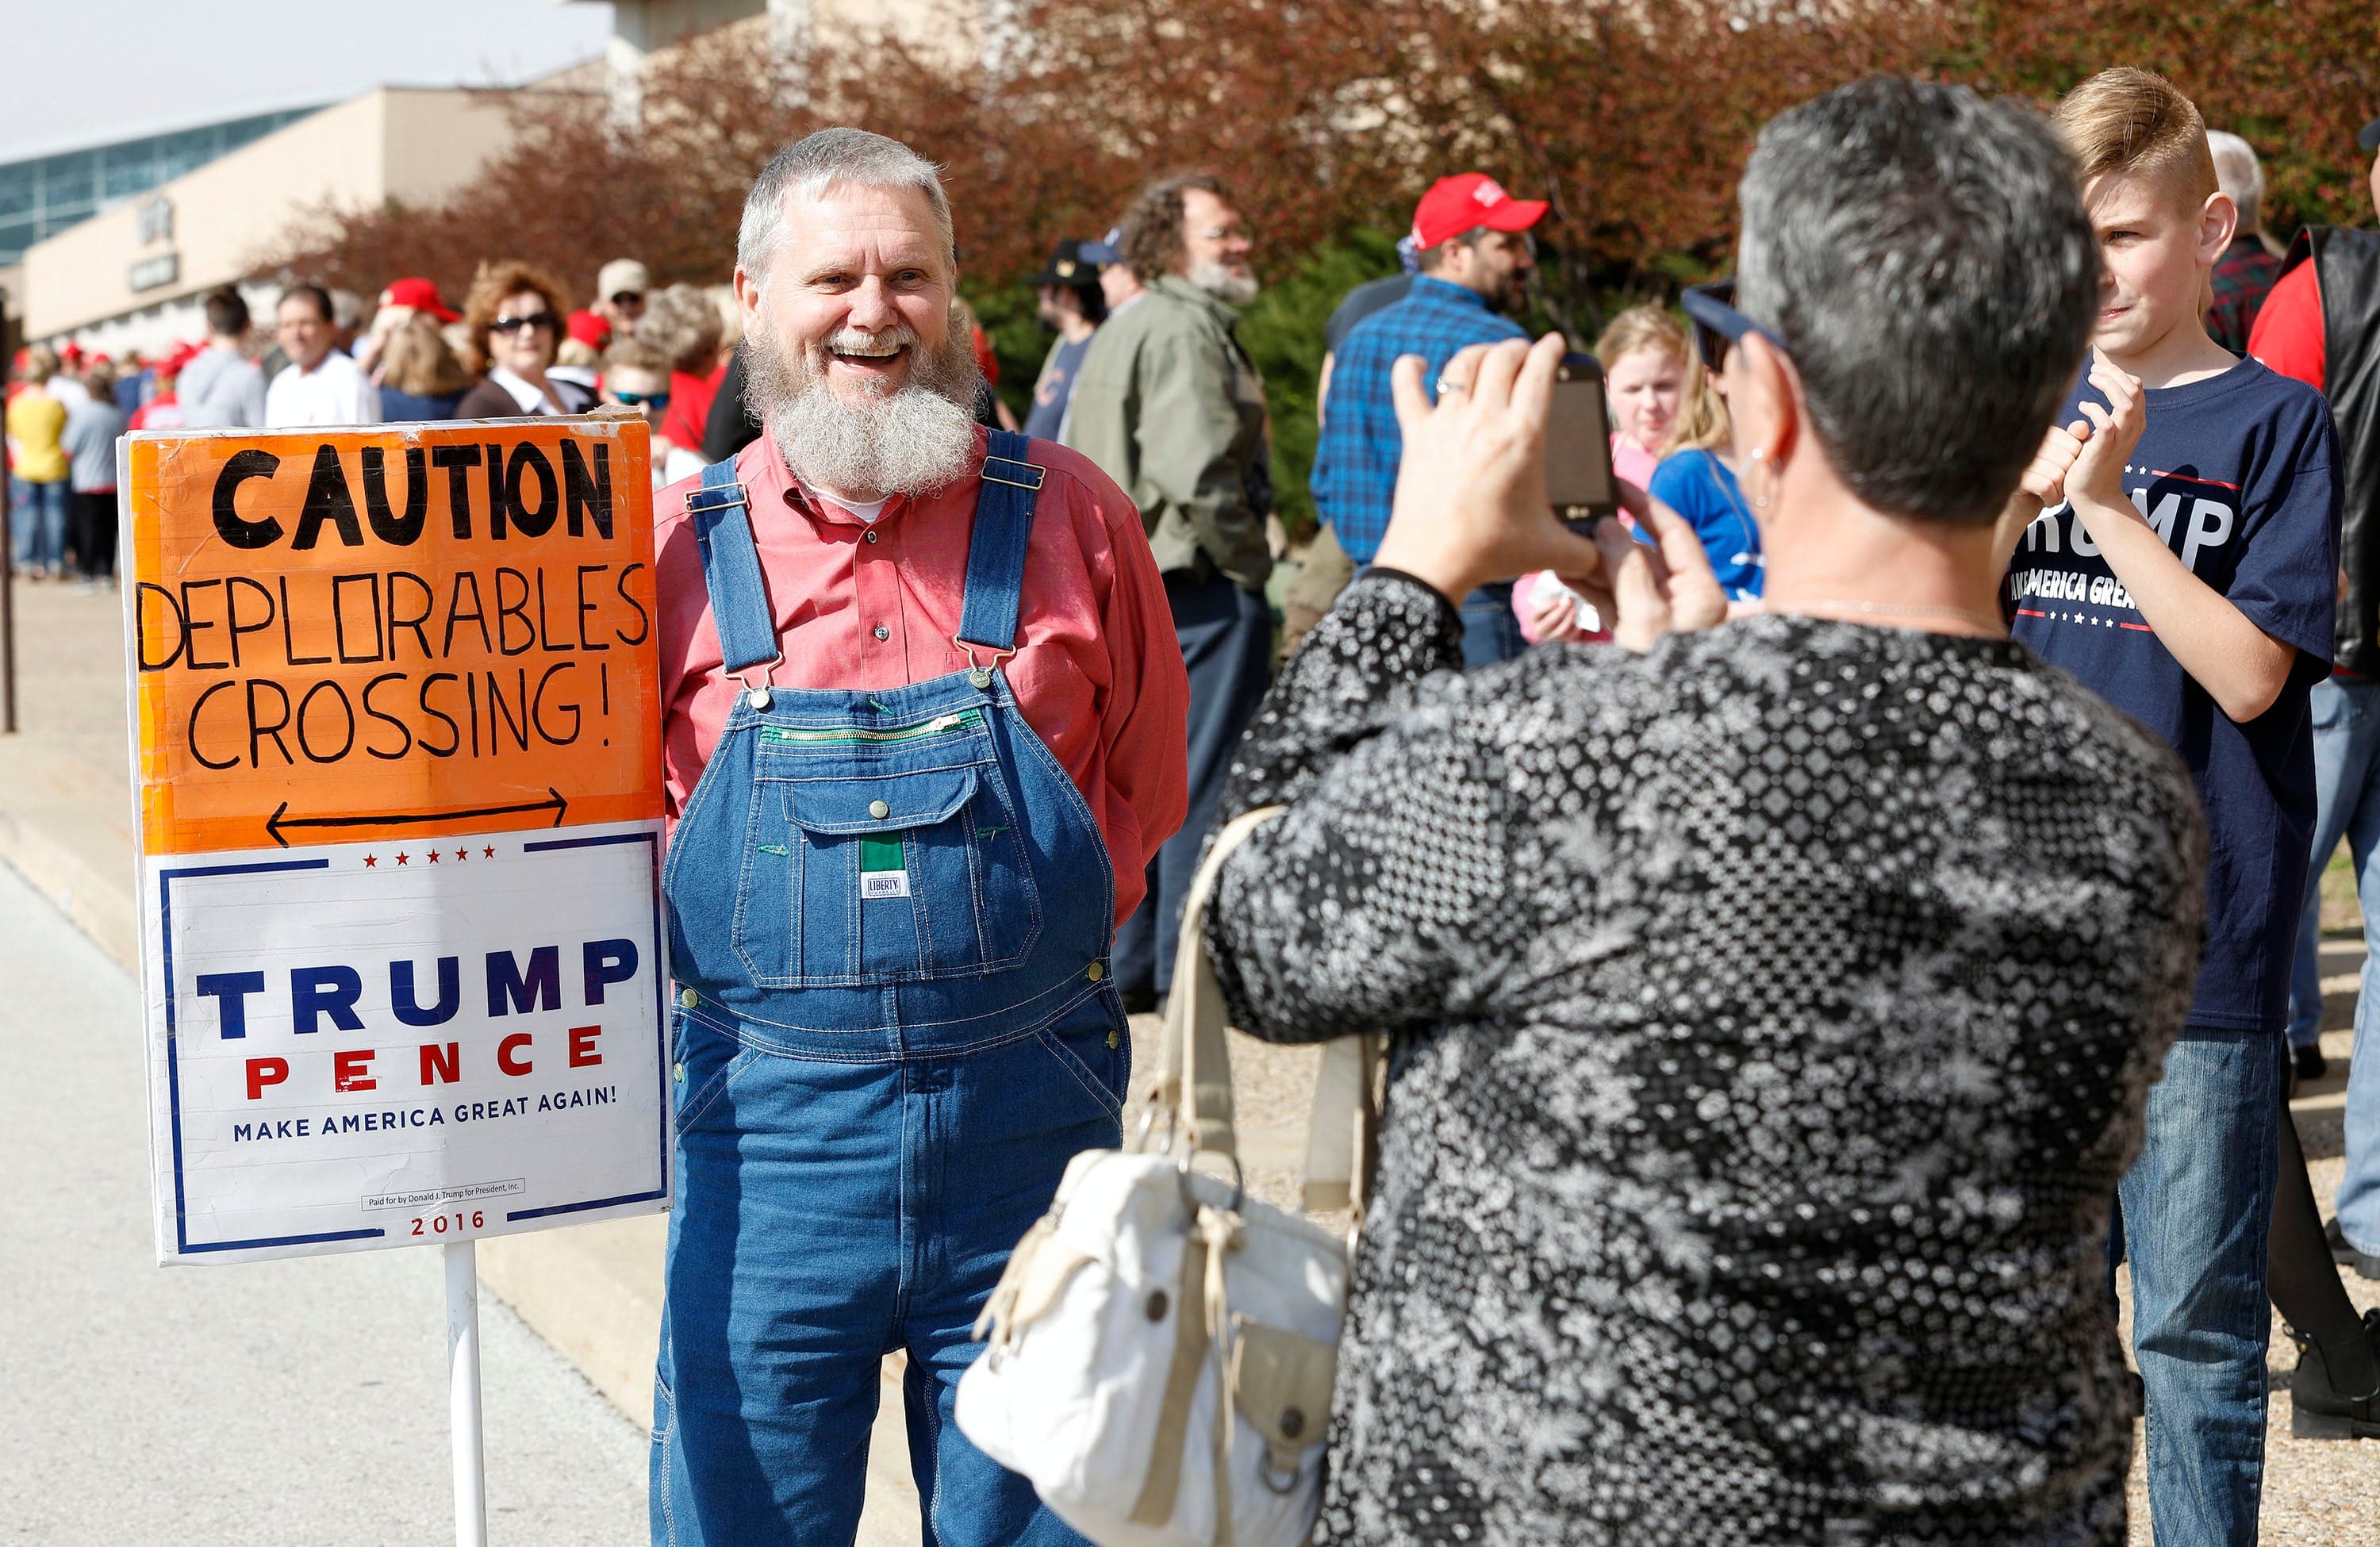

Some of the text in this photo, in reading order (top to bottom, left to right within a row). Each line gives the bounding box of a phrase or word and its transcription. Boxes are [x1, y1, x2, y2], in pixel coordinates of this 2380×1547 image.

[213, 438, 614, 550] CAUTION
[2024, 487, 2234, 573] RMP
[136, 562, 648, 673] DEPLORABLES
[2010, 568, 2139, 610] AKE MERICA GREA
[189, 662, 609, 770] CROSSING!
[869, 879, 898, 891] LIBERTY
[197, 938, 639, 1040] TRUMP
[246, 1025, 604, 1100] PENCE
[234, 1085, 616, 1142] MAKE AMERICA GREAT AGAIN!
[369, 1196, 385, 1207] Paid
[397, 1196, 407, 1205] by
[409, 1192, 434, 1203] Donald
[475, 1184, 507, 1195] President,
[411, 1211, 484, 1236] 2016
